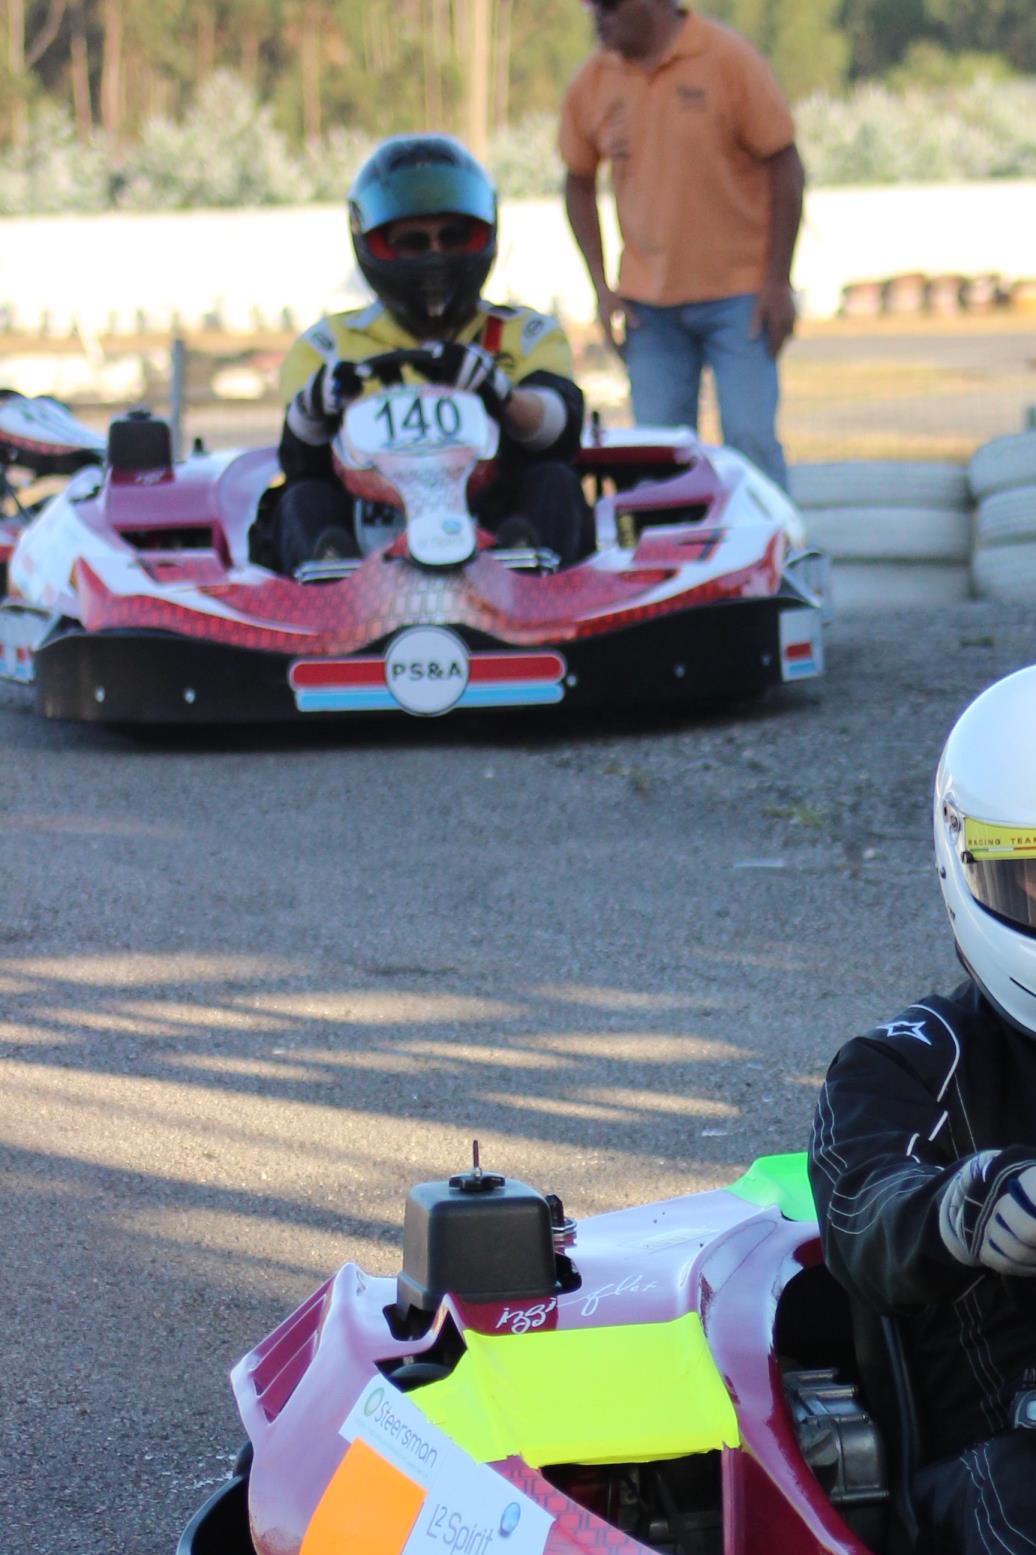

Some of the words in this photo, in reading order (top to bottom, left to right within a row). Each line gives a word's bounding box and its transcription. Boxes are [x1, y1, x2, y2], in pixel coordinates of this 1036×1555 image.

[374, 396, 461, 441] 140
[392, 662, 462, 681] PS&A
[968, 838, 1001, 847] RACING
[374, 1400, 438, 1469] Steersman
